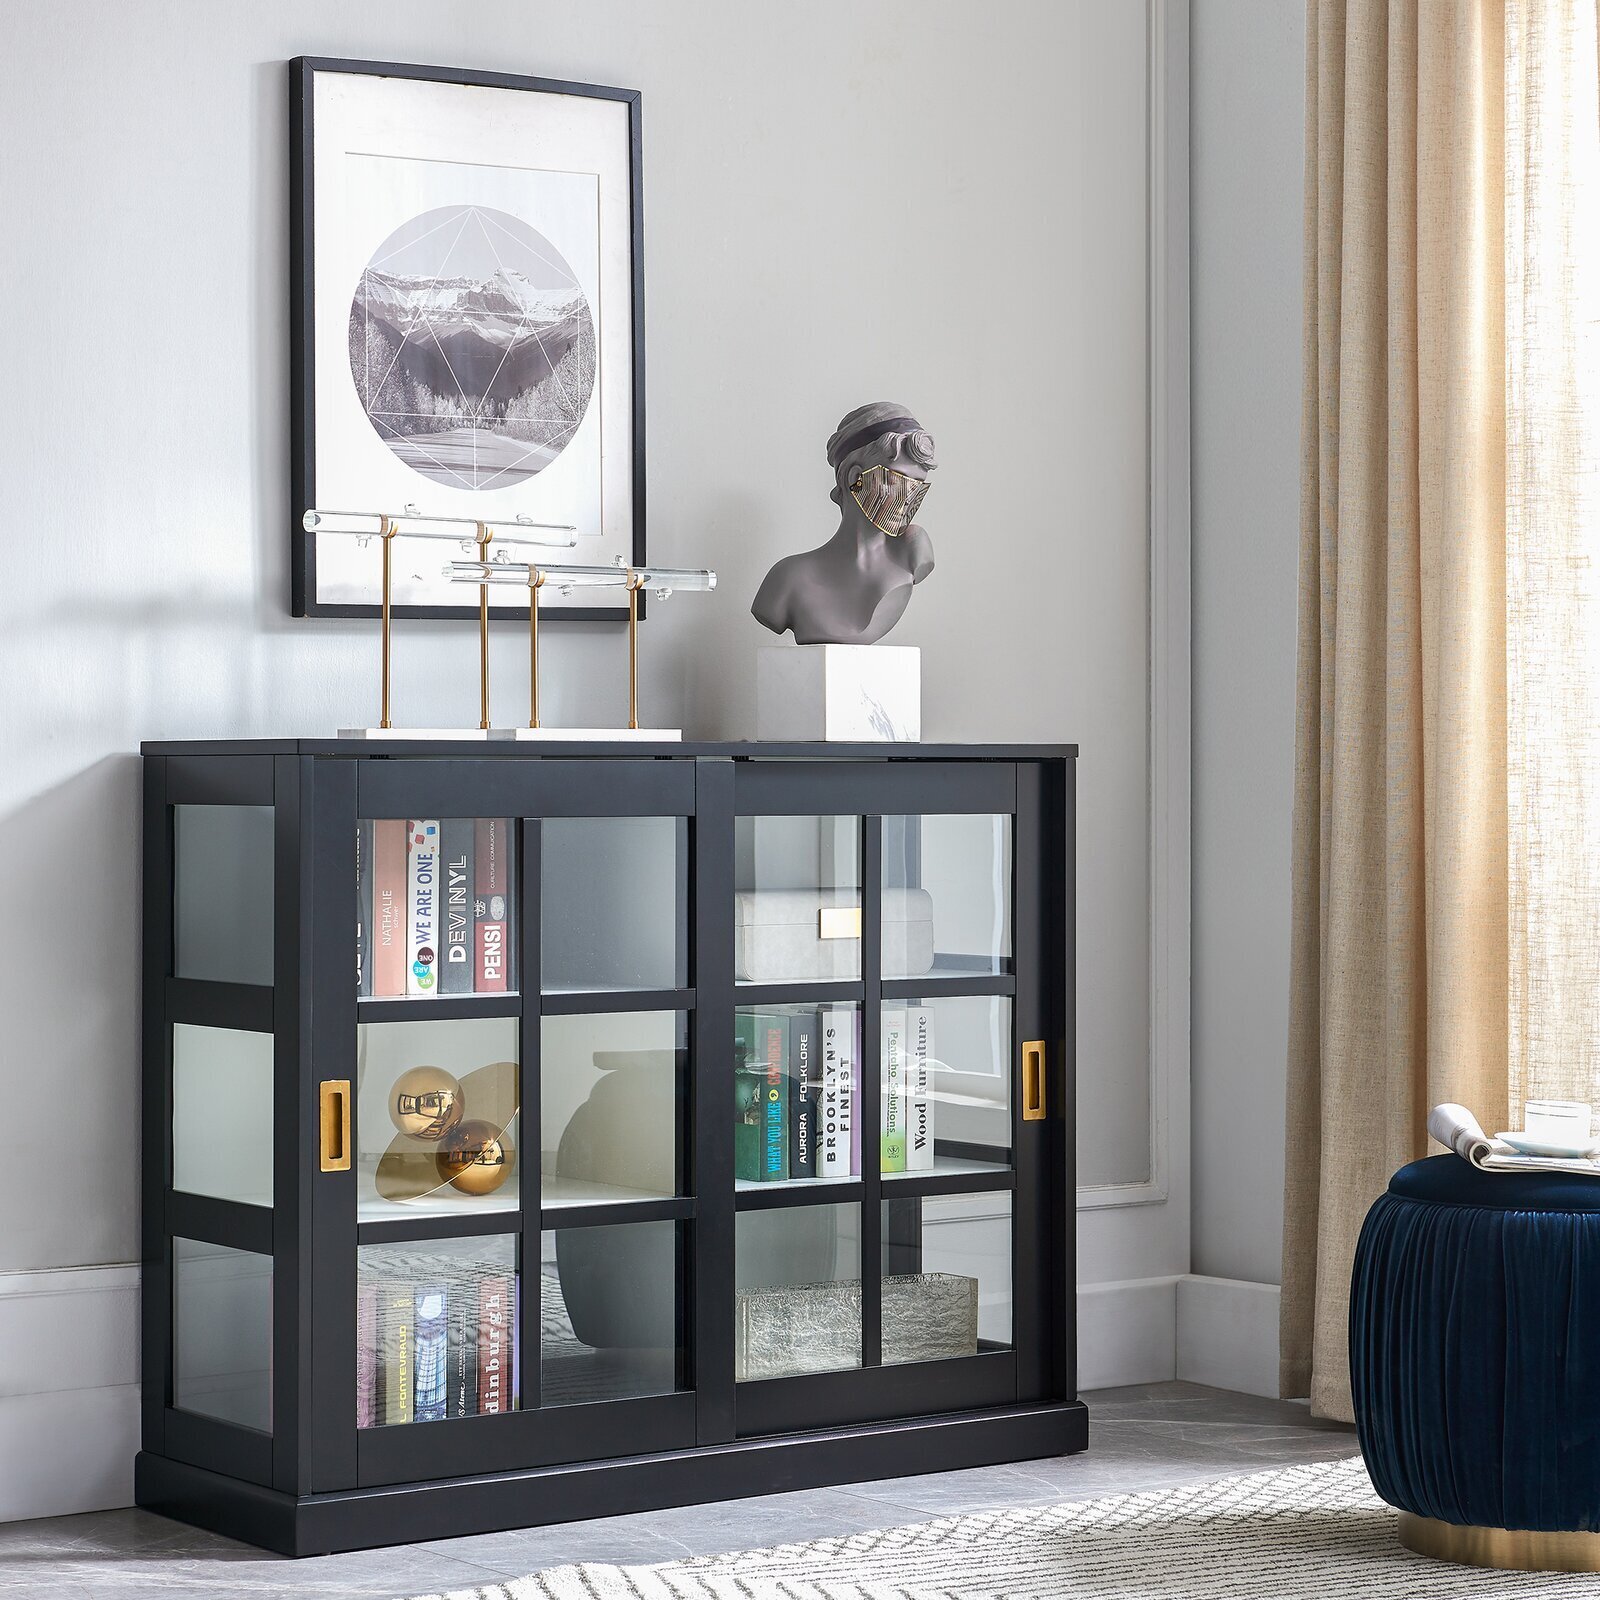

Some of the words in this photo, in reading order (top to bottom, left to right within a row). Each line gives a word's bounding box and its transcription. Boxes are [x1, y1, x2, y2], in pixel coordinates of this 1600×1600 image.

[417, 853, 433, 884] ONE
[382, 890, 392, 946] NATHALIE
[416, 889, 432, 917] ARE
[449, 855, 467, 963] DEVINYL
[415, 921, 431, 945] WE
[484, 925, 501, 980] PENSI
[767, 1028, 781, 1085] CONFIDENCE
[799, 1033, 808, 1103] FOLKLORE
[890, 1031, 899, 1078] Pentaho
[914, 1016, 927, 1096] Furniture
[767, 1102, 781, 1123] LIKE
[826, 1028, 836, 1163] BROOKLYN'S
[840, 1057, 850, 1132] FINEST
[889, 1082, 899, 1134] Solutions
[767, 1125, 782, 1144] YOU
[799, 1112, 807, 1164] AURORA
[914, 1102, 927, 1151] Wood
[767, 1146, 781, 1173] WHAT
[399, 1325, 407, 1411] FONTEVRAUD
